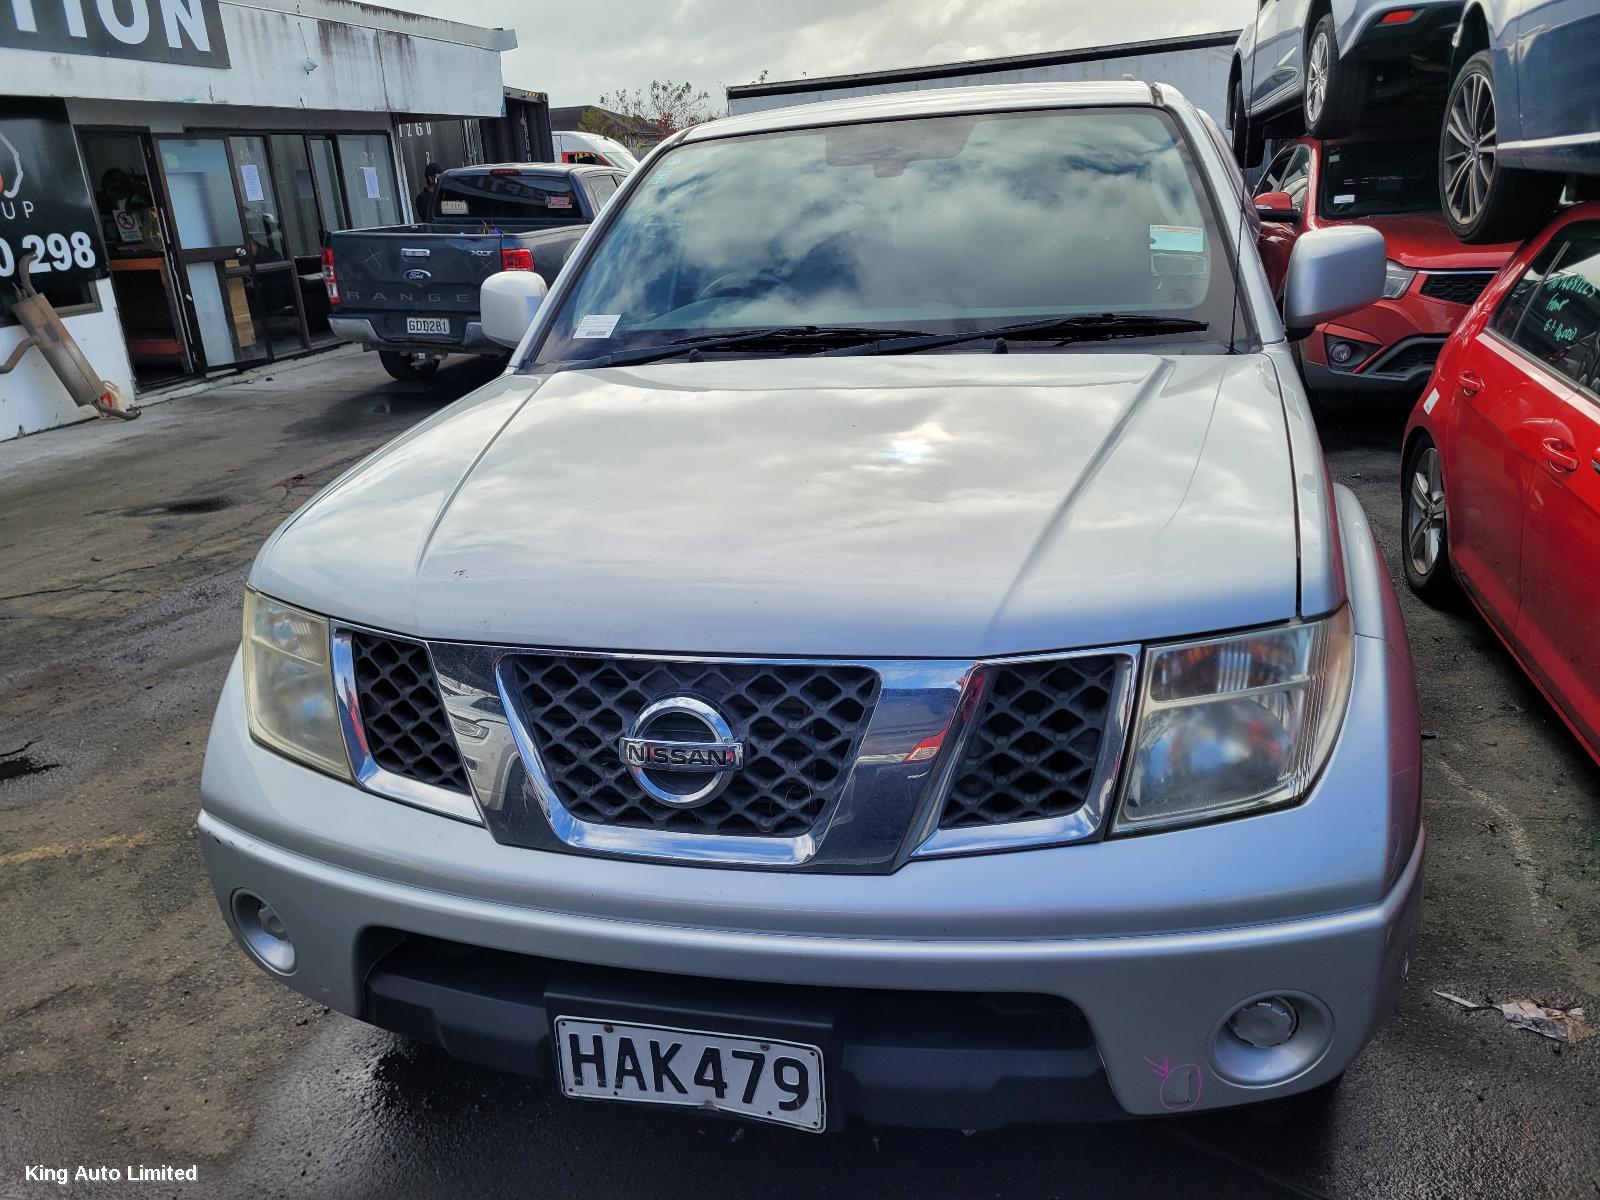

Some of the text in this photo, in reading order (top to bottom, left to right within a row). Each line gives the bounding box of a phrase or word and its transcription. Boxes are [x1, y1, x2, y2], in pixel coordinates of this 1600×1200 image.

[22, 230, 96, 274] 298
[408, 319, 448, 334] GDD281
[627, 744, 729, 767] NISSAN
[568, 1033, 810, 1112] HAK479
